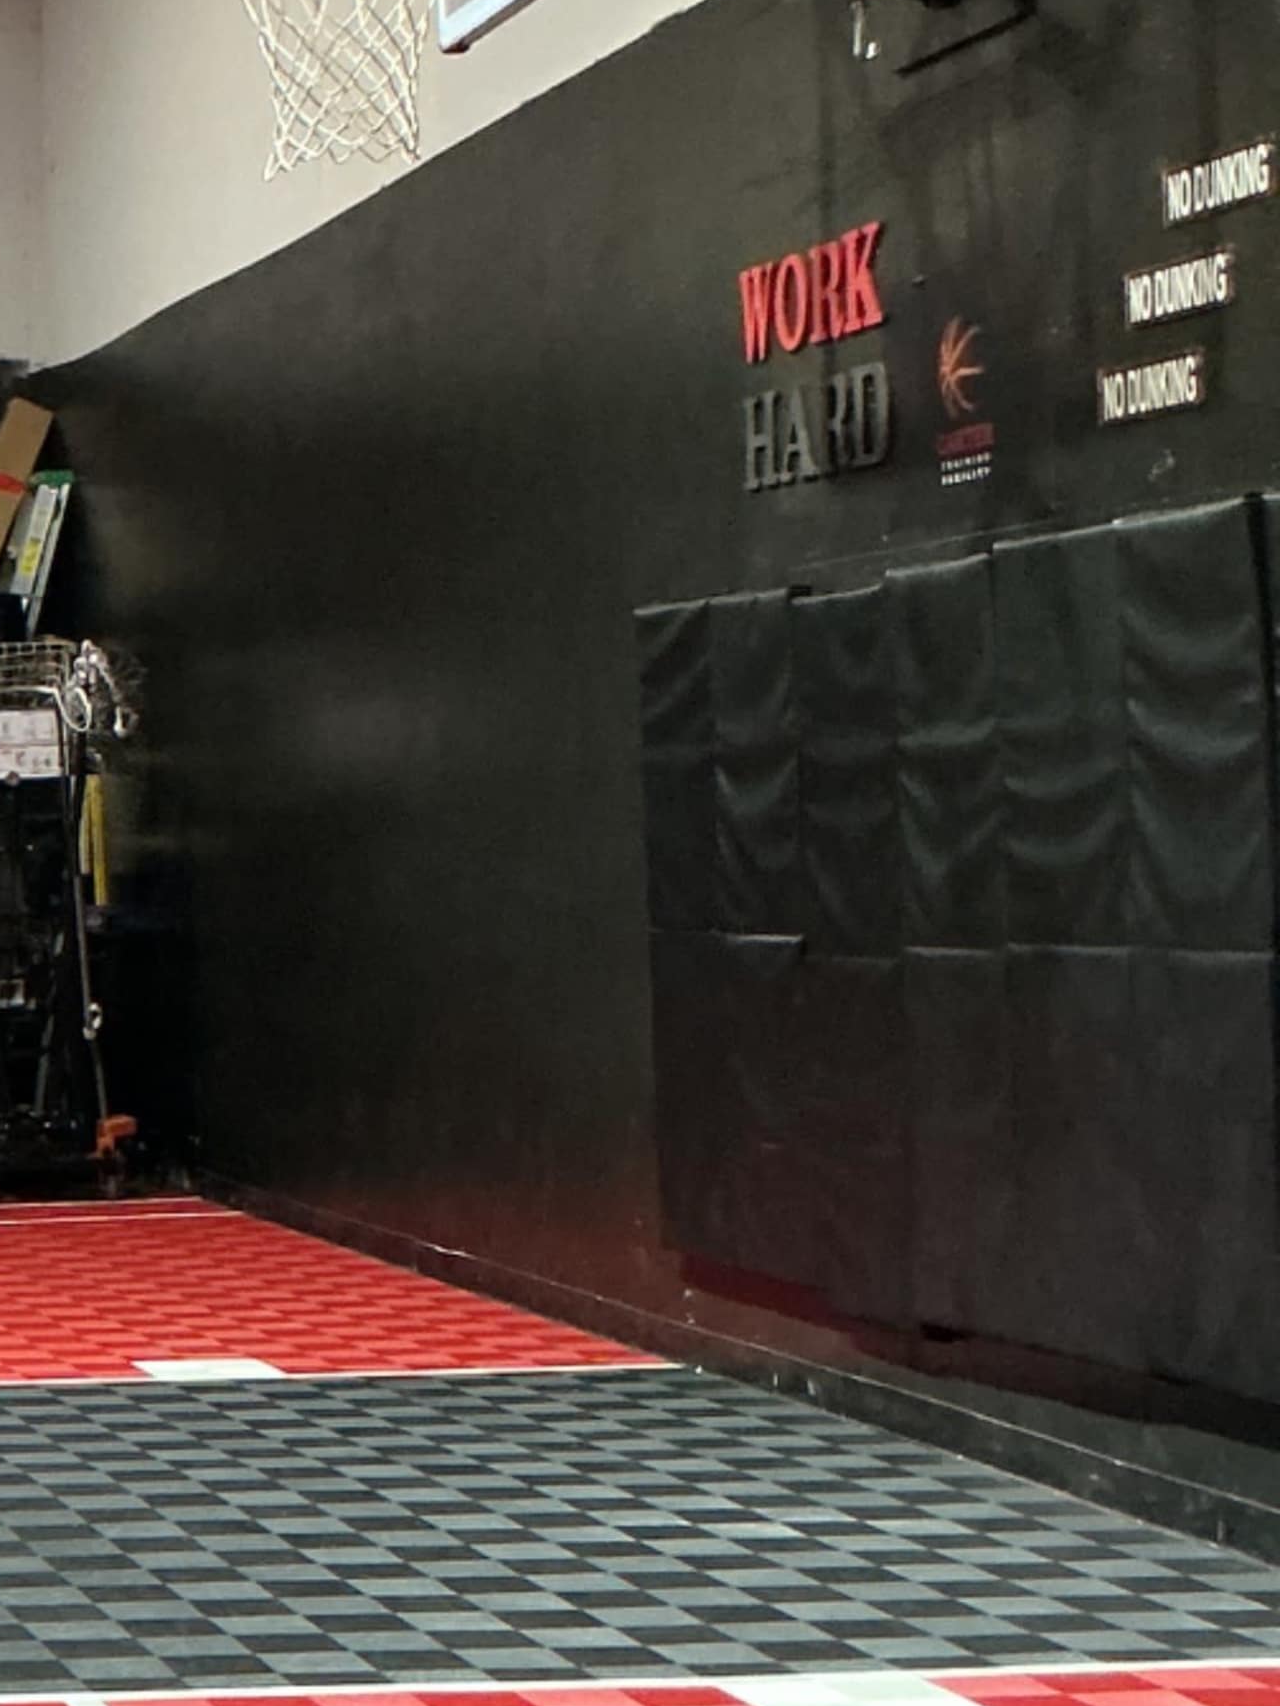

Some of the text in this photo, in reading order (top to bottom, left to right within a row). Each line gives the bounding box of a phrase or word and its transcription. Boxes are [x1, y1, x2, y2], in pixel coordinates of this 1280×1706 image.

[1167, 143, 1269, 221] NO DUNKING
[740, 221, 883, 364] WORK
[1129, 253, 1227, 323] NO DUNKING
[742, 362, 886, 492] HARD
[1103, 355, 1197, 421] NO DUNKING
